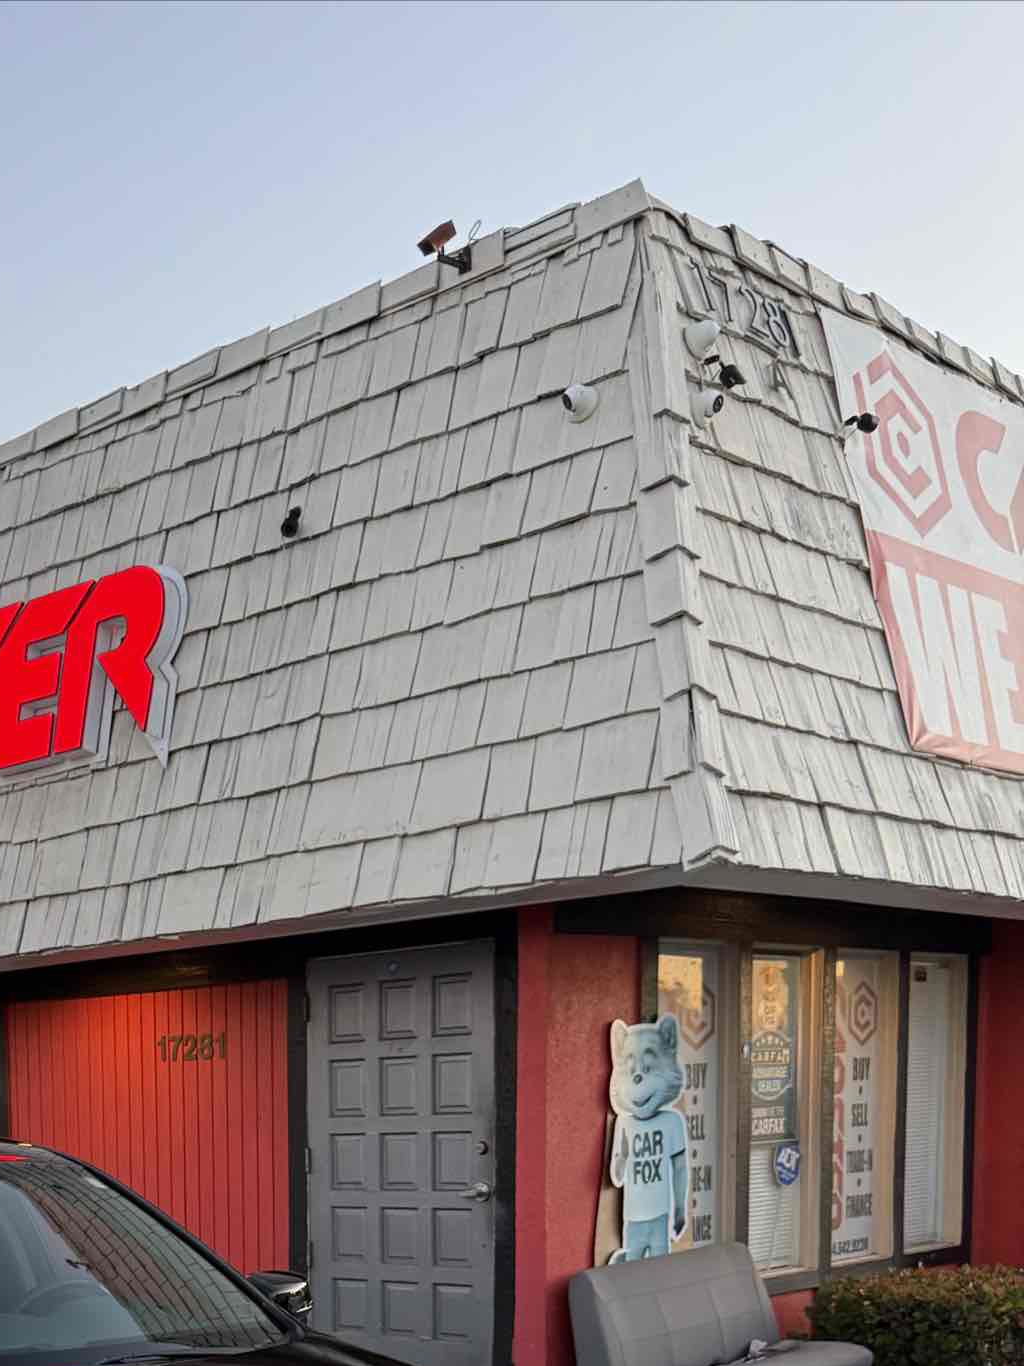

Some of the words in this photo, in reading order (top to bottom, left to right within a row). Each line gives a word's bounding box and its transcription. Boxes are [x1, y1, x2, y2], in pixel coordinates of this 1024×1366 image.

[954, 409, 1024, 556] C
[157, 1032, 225, 1061] 17281
[685, 1062, 708, 1089] BUY
[852, 1056, 871, 1081] BUY
[851, 1103, 869, 1127] SELL
[632, 1129, 664, 1158] CAR
[633, 1157, 663, 1185] FOX
